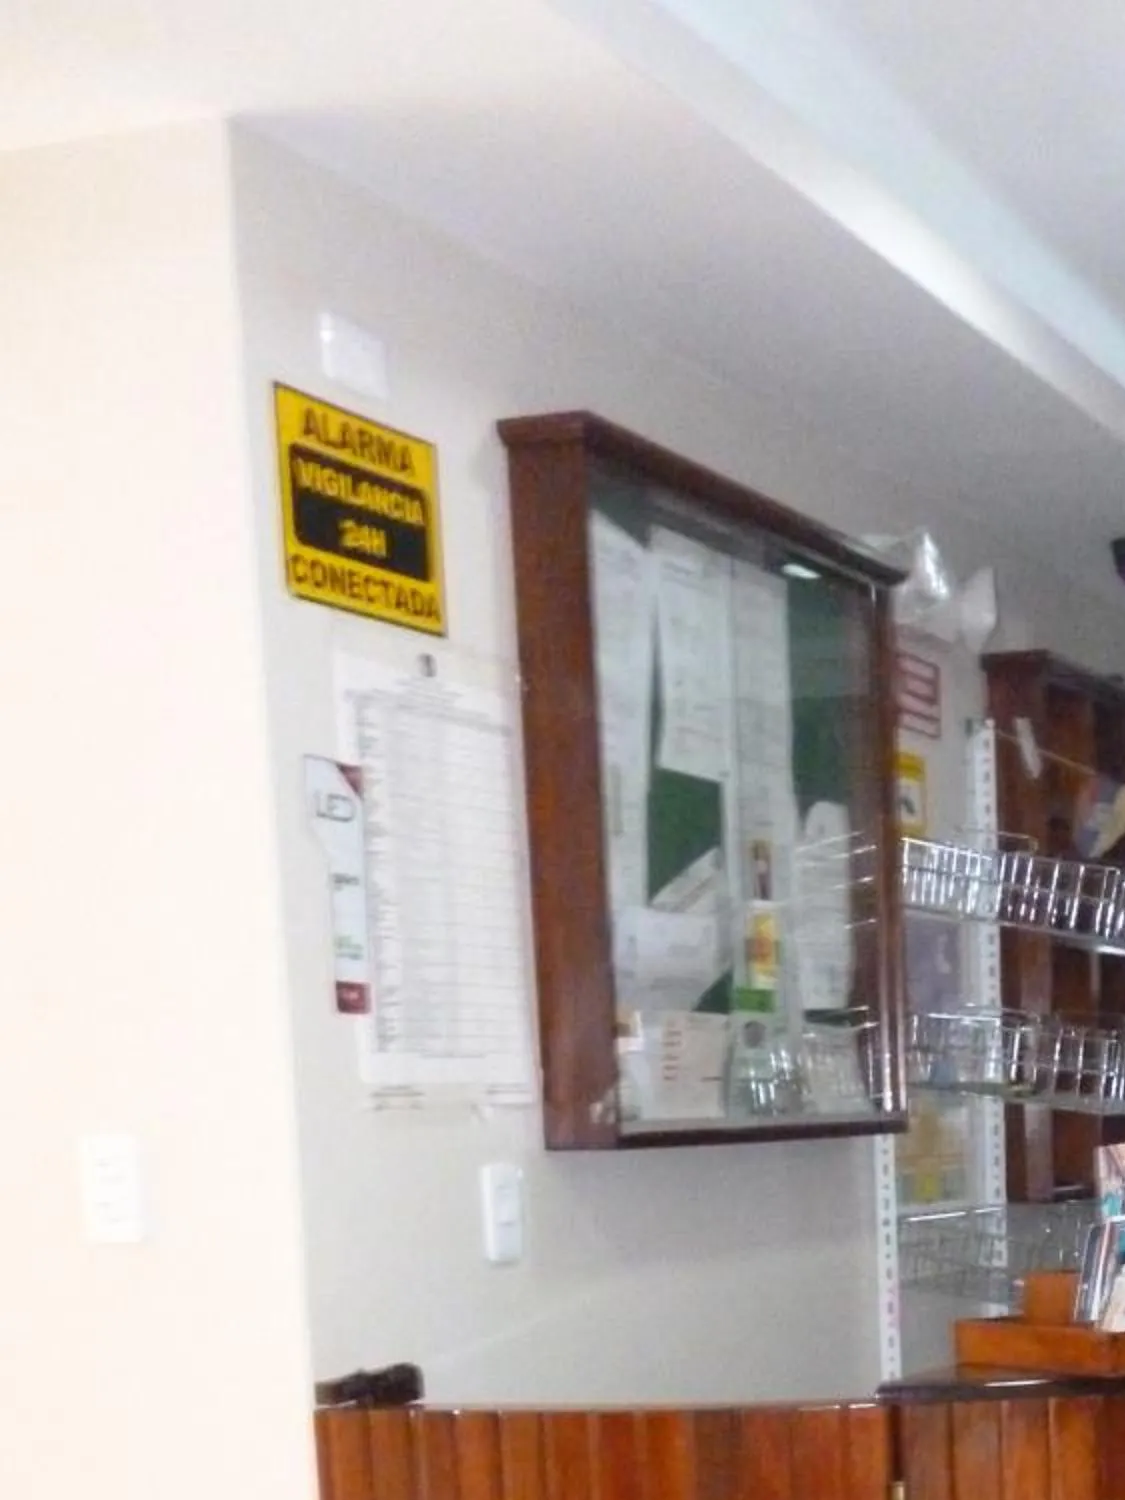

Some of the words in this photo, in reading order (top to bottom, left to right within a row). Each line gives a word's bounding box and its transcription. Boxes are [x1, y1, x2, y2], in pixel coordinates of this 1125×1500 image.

[303, 408, 413, 473] ALARMA
[293, 459, 424, 525] VIGILANCIA
[291, 554, 440, 620] CONECTADA
